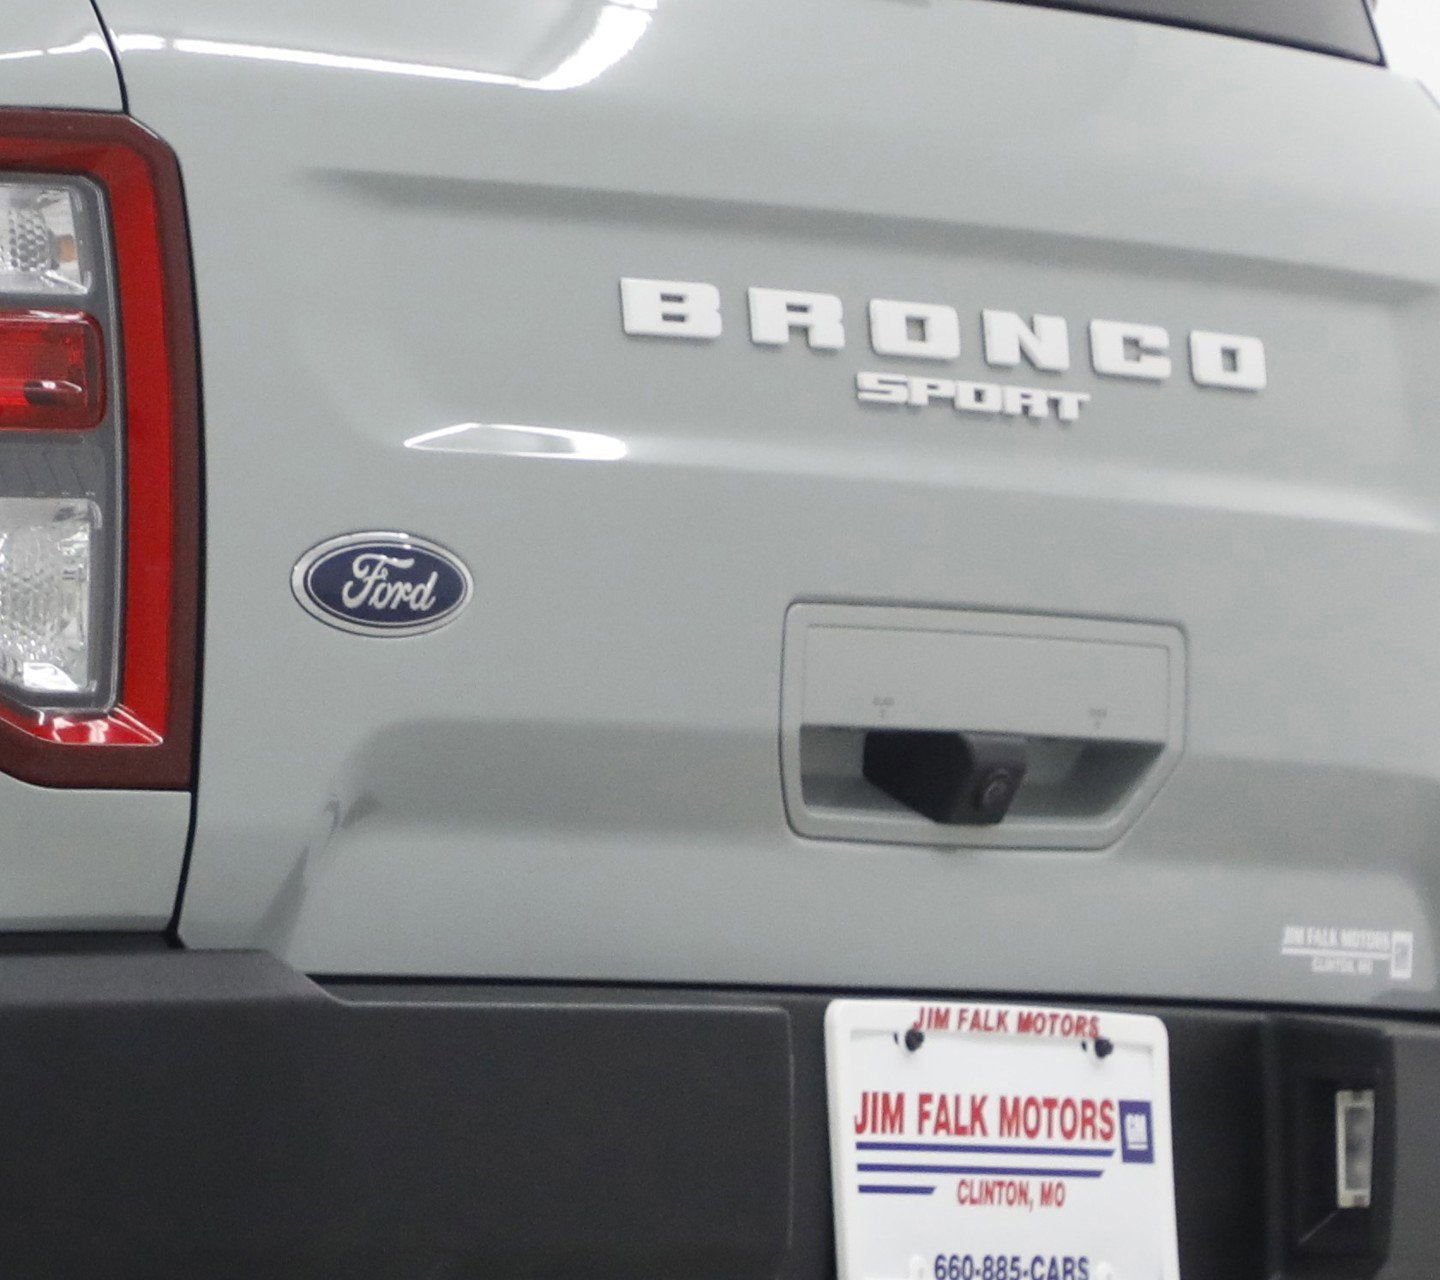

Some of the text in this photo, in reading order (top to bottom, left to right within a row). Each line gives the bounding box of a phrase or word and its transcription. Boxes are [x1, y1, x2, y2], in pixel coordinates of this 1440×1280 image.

[619, 277, 1267, 391] BRONCO
[855, 371, 1091, 421] SPORT
[341, 553, 439, 611] Ford
[913, 1007, 1101, 1039] JIM FALK MOTORS
[854, 1091, 1115, 1142] JIM FALK MOTORS
[957, 1179, 1066, 1211] CLINTON, MO
